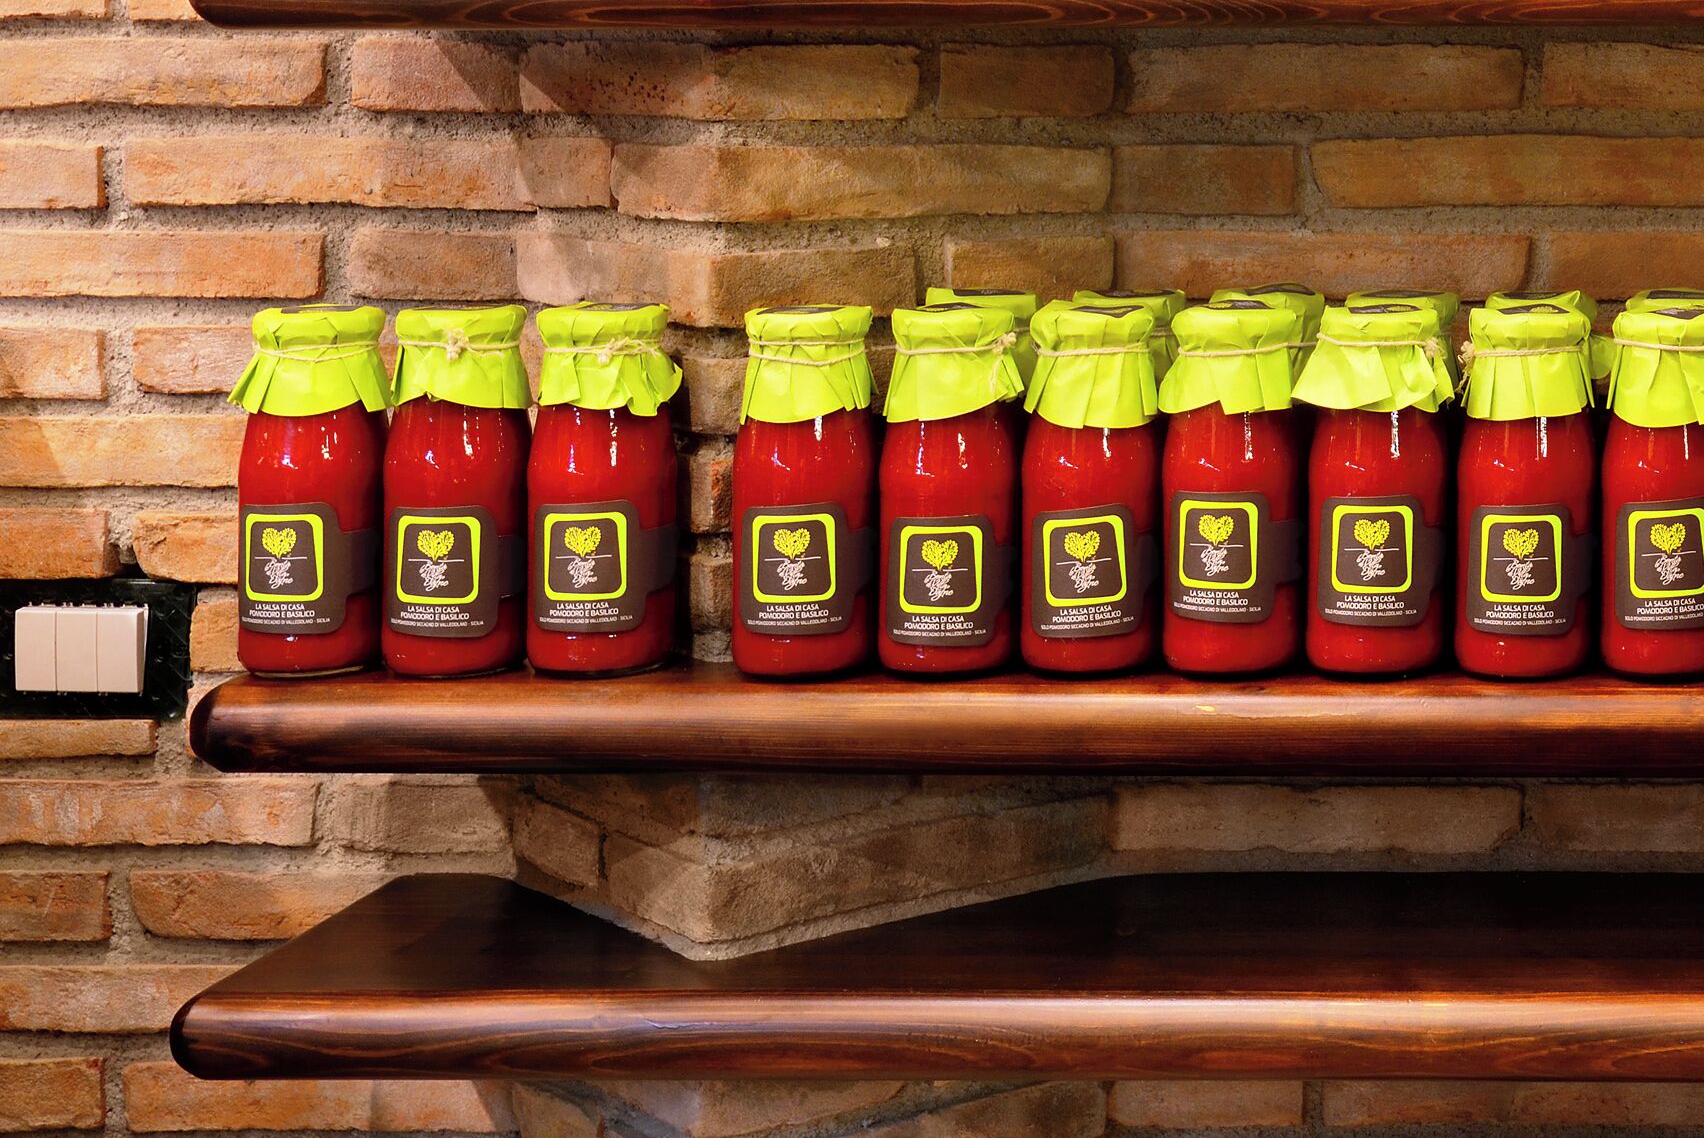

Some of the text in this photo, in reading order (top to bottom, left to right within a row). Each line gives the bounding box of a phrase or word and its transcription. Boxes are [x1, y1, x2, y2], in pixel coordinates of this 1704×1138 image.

[803, 603, 819, 611] CASA
[1653, 599, 1673, 607] SALSA
[1637, 606, 1673, 615] POMODORO
[1679, 603, 1704, 612] BASILICO
[400, 612, 434, 620] POMODORO
[441, 612, 470, 620] BASILICO
[801, 609, 829, 618] BASILICO
[904, 622, 940, 630] POMODORO
[946, 621, 974, 629] BASILICO
